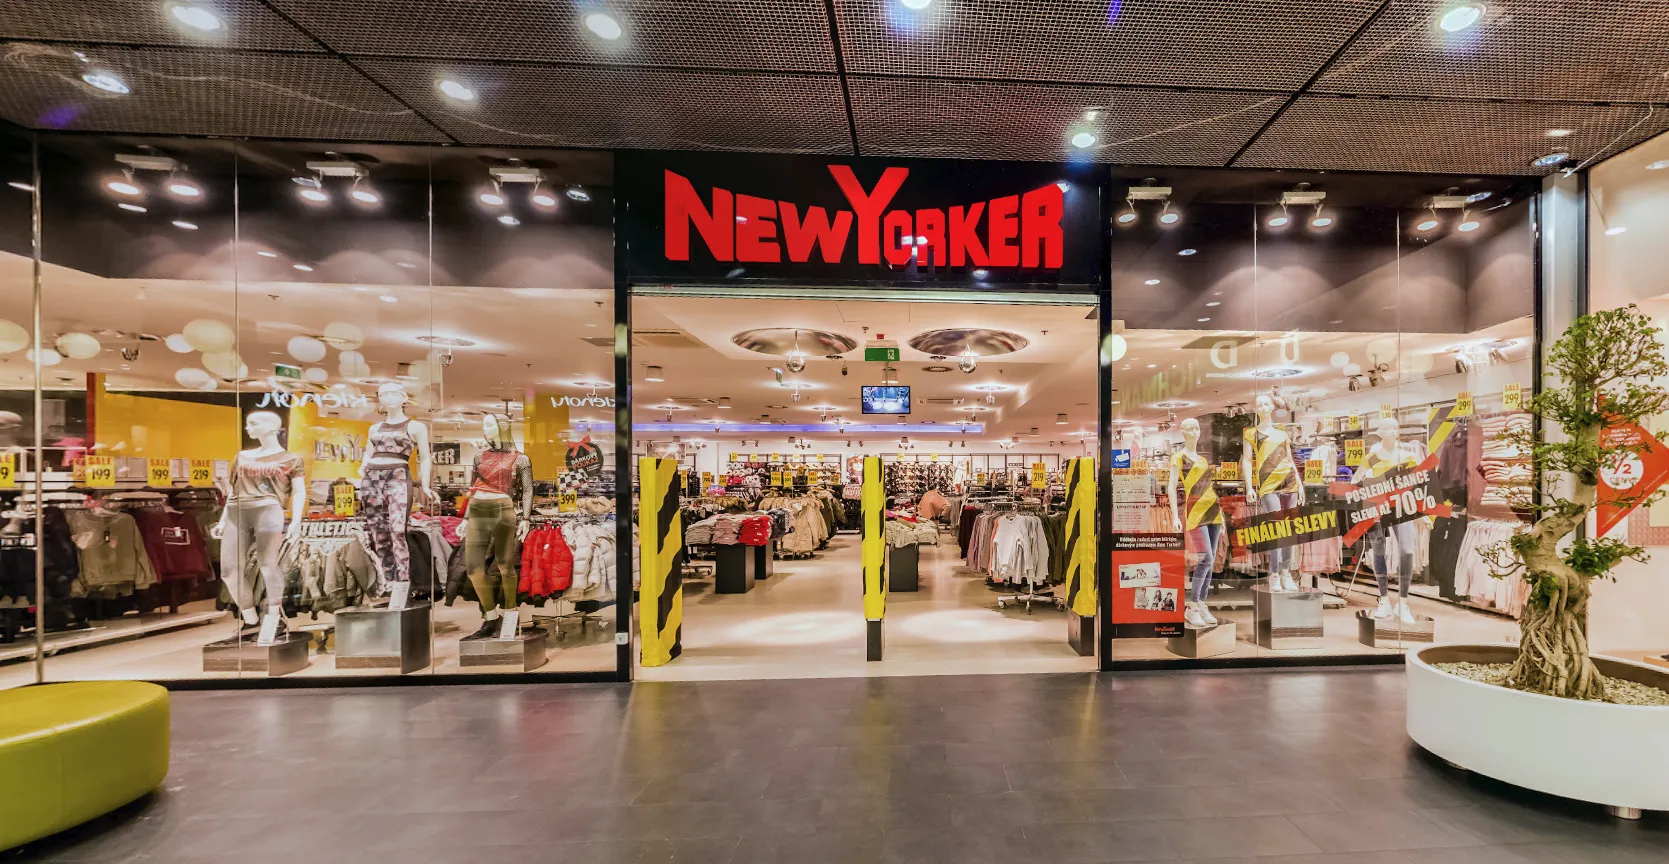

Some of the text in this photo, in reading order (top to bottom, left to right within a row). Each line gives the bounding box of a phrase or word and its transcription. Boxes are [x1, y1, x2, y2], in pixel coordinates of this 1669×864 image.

[1504, 383, 1519, 392] SALE
[1504, 393, 1519, 405] 299
[1458, 400, 1471, 411] 299
[1346, 440, 1363, 448] SALE
[1347, 449, 1363, 459] 799
[88, 457, 112, 466] SALE
[150, 459, 170, 467] SALE
[191, 460, 211, 468] SALE
[1306, 460, 1322, 468] SALE
[92, 467, 111, 480] 199
[152, 468, 169, 480] 199
[192, 469, 209, 480] 219
[1033, 472, 1044, 482] 219
[1222, 470, 1237, 480] 399
[1306, 469, 1321, 479] 299
[335, 486, 353, 495] SALE
[1345, 469, 1431, 504] POSLEDNÍ ŠANCE
[336, 496, 353, 509] 299
[560, 494, 576, 505] 399
[1351, 485, 1437, 524] SLEVA AŽ 70%
[1236, 510, 1338, 547] FINÁLNÍ SLEVY
